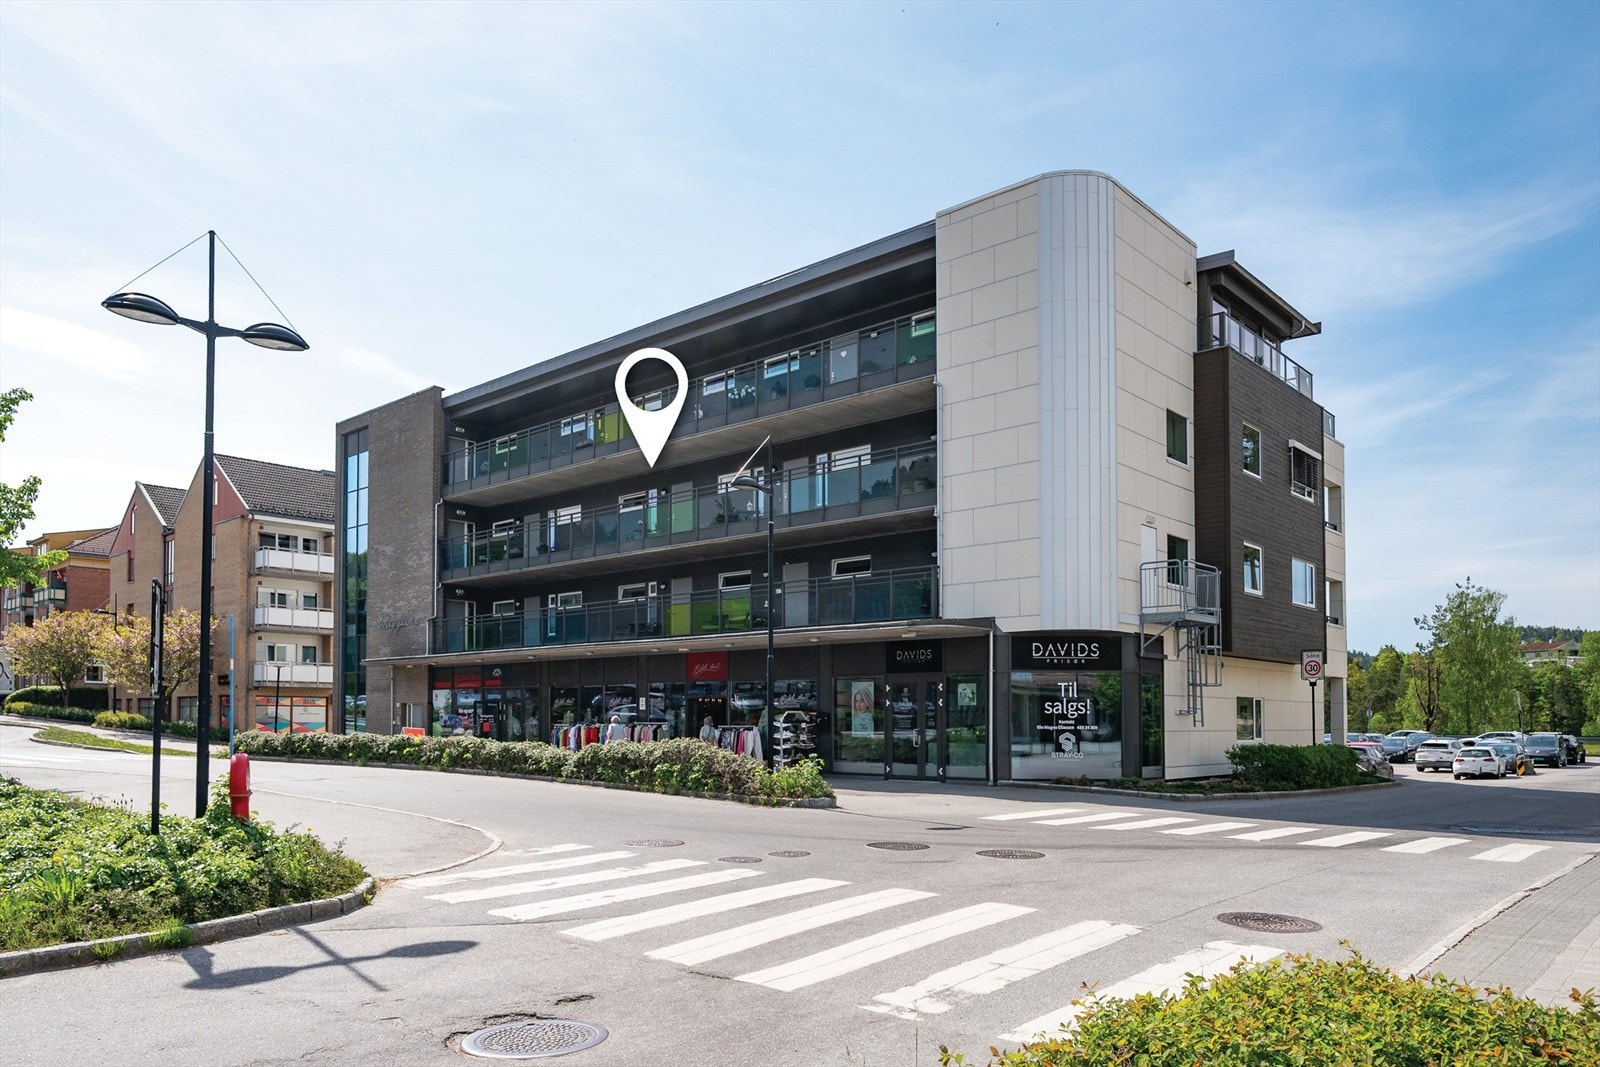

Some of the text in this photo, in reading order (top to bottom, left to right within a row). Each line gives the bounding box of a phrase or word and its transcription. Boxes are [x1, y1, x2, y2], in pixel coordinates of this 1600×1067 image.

[896, 649, 932, 660] DAVIDS
[1032, 642, 1100, 657] DAVIDS
[1308, 664, 1318, 672] 30
[1057, 681, 1078, 698] Til
[1044, 697, 1090, 719] salgs!
